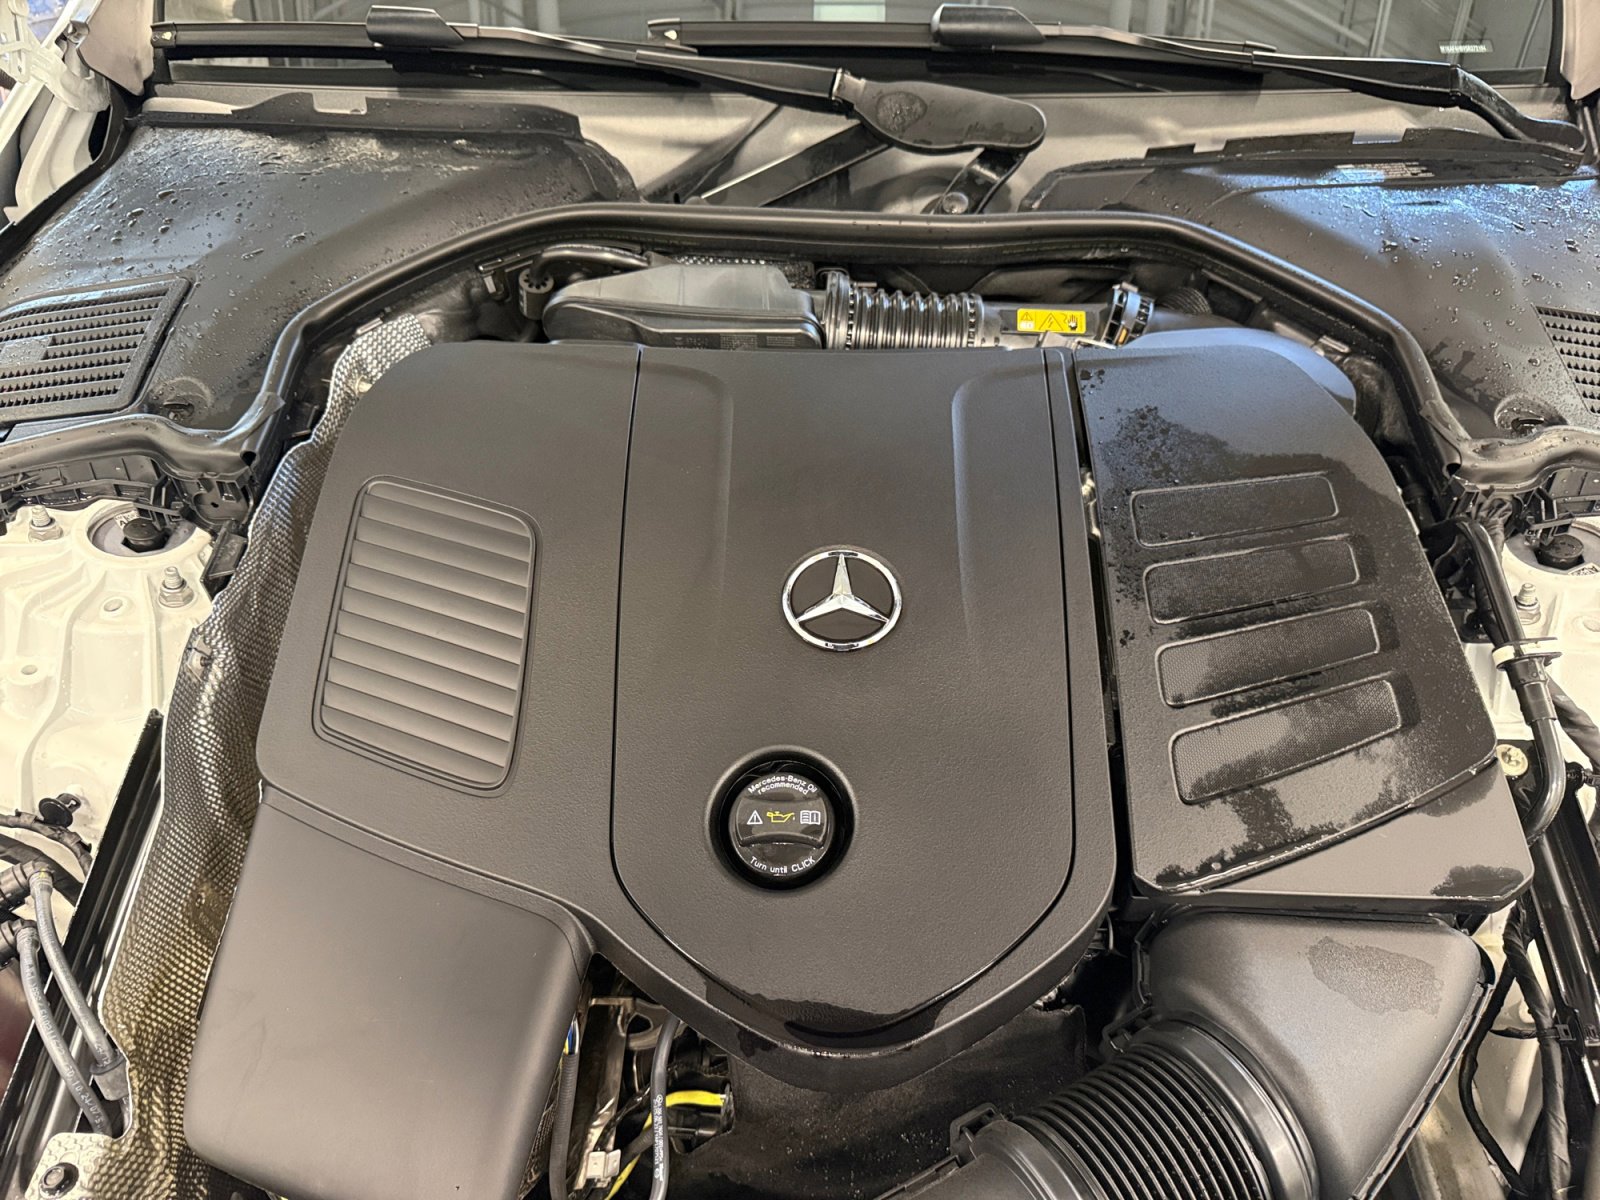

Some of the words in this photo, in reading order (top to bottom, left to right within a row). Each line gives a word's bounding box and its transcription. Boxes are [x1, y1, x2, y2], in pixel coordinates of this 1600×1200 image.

[748, 775, 807, 793] Mercedes-Benz
[807, 783, 818, 793] Oil
[757, 782, 809, 795] recommended
[750, 856, 767, 871] Turn
[770, 865, 788, 874] until
[791, 856, 816, 872] CLICK
